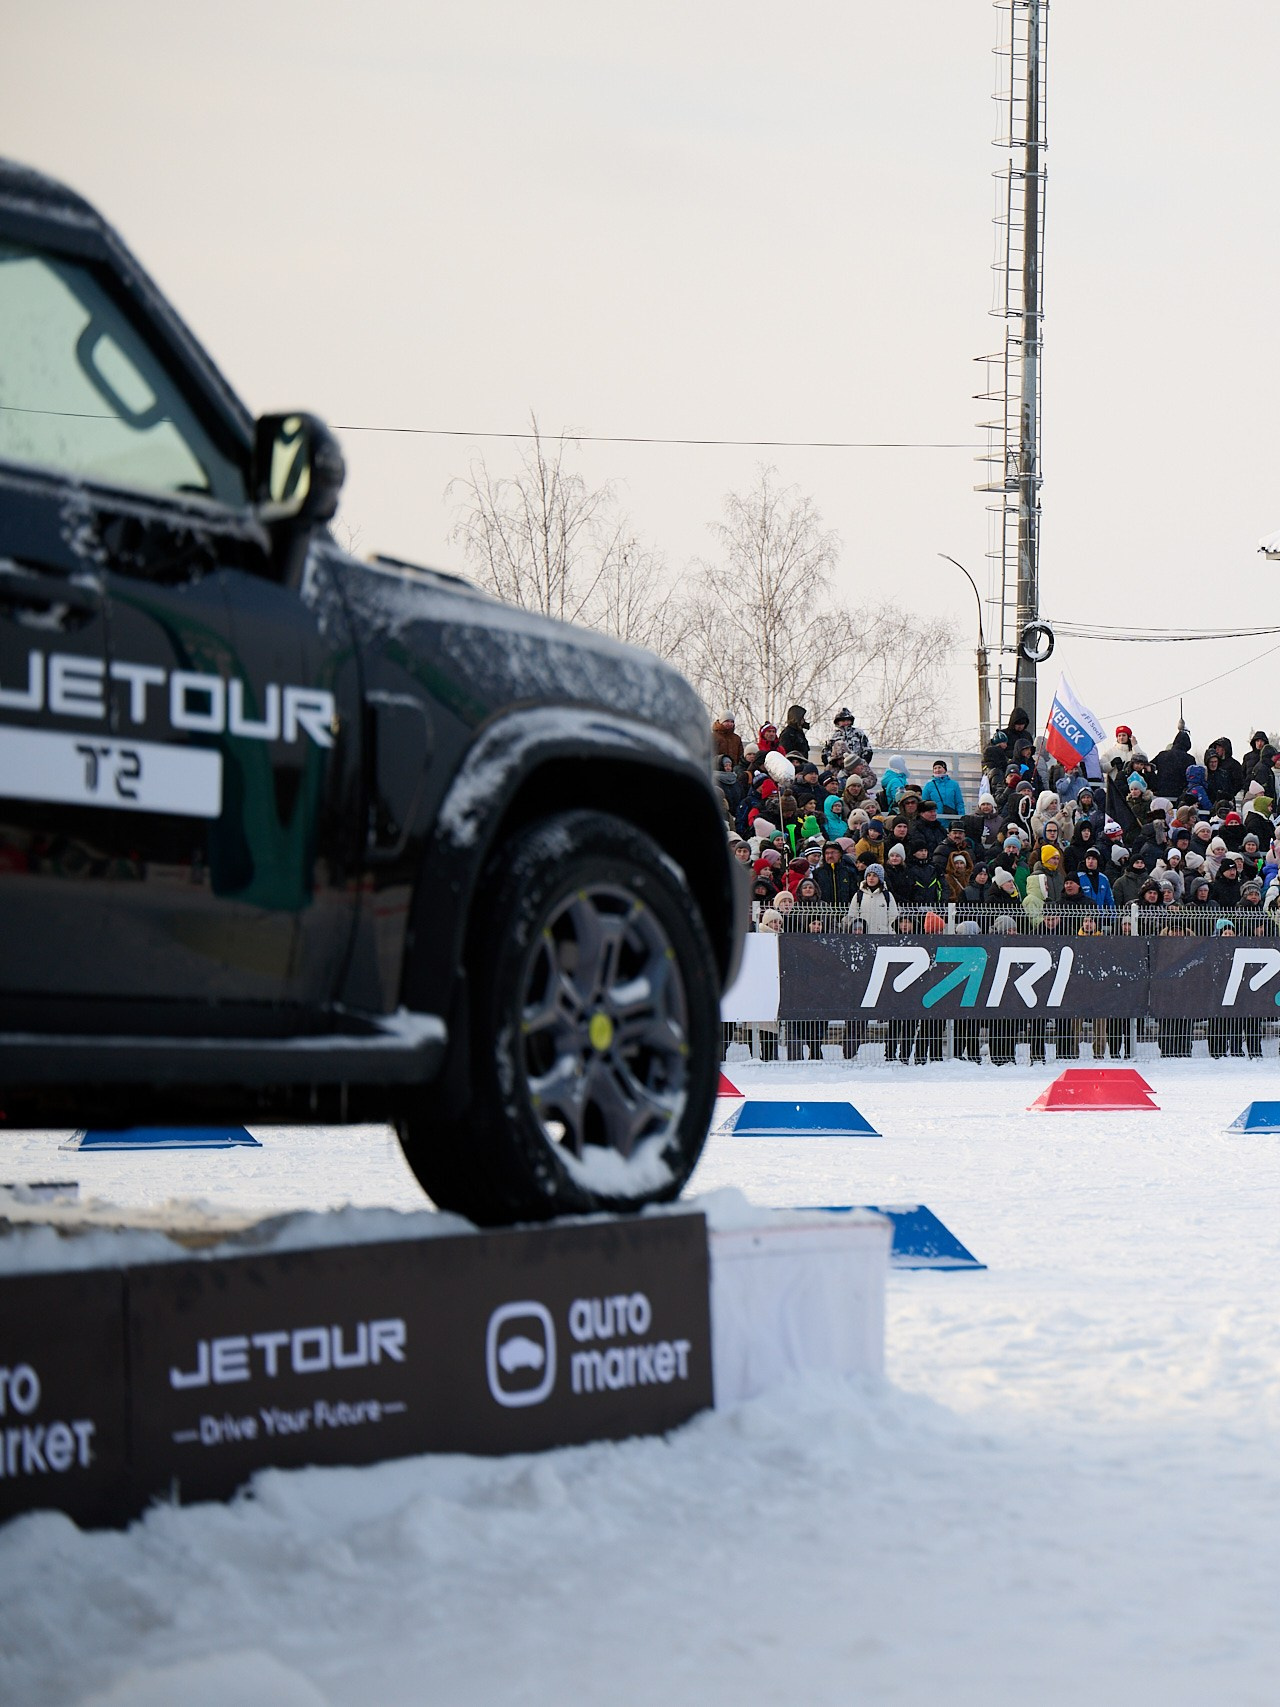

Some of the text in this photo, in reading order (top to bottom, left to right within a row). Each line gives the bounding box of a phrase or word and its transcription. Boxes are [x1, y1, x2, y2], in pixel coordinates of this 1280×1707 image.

[0, 650, 336, 748] JETOUR
[76, 744, 142, 800] T2
[860, 946, 1074, 1008] PARI
[568, 1290, 652, 1343] auto
[169, 1317, 407, 1391] JETOUR
[571, 1337, 692, 1396] market
[199, 1413, 258, 1447] Drive
[259, 1404, 310, 1437] Your
